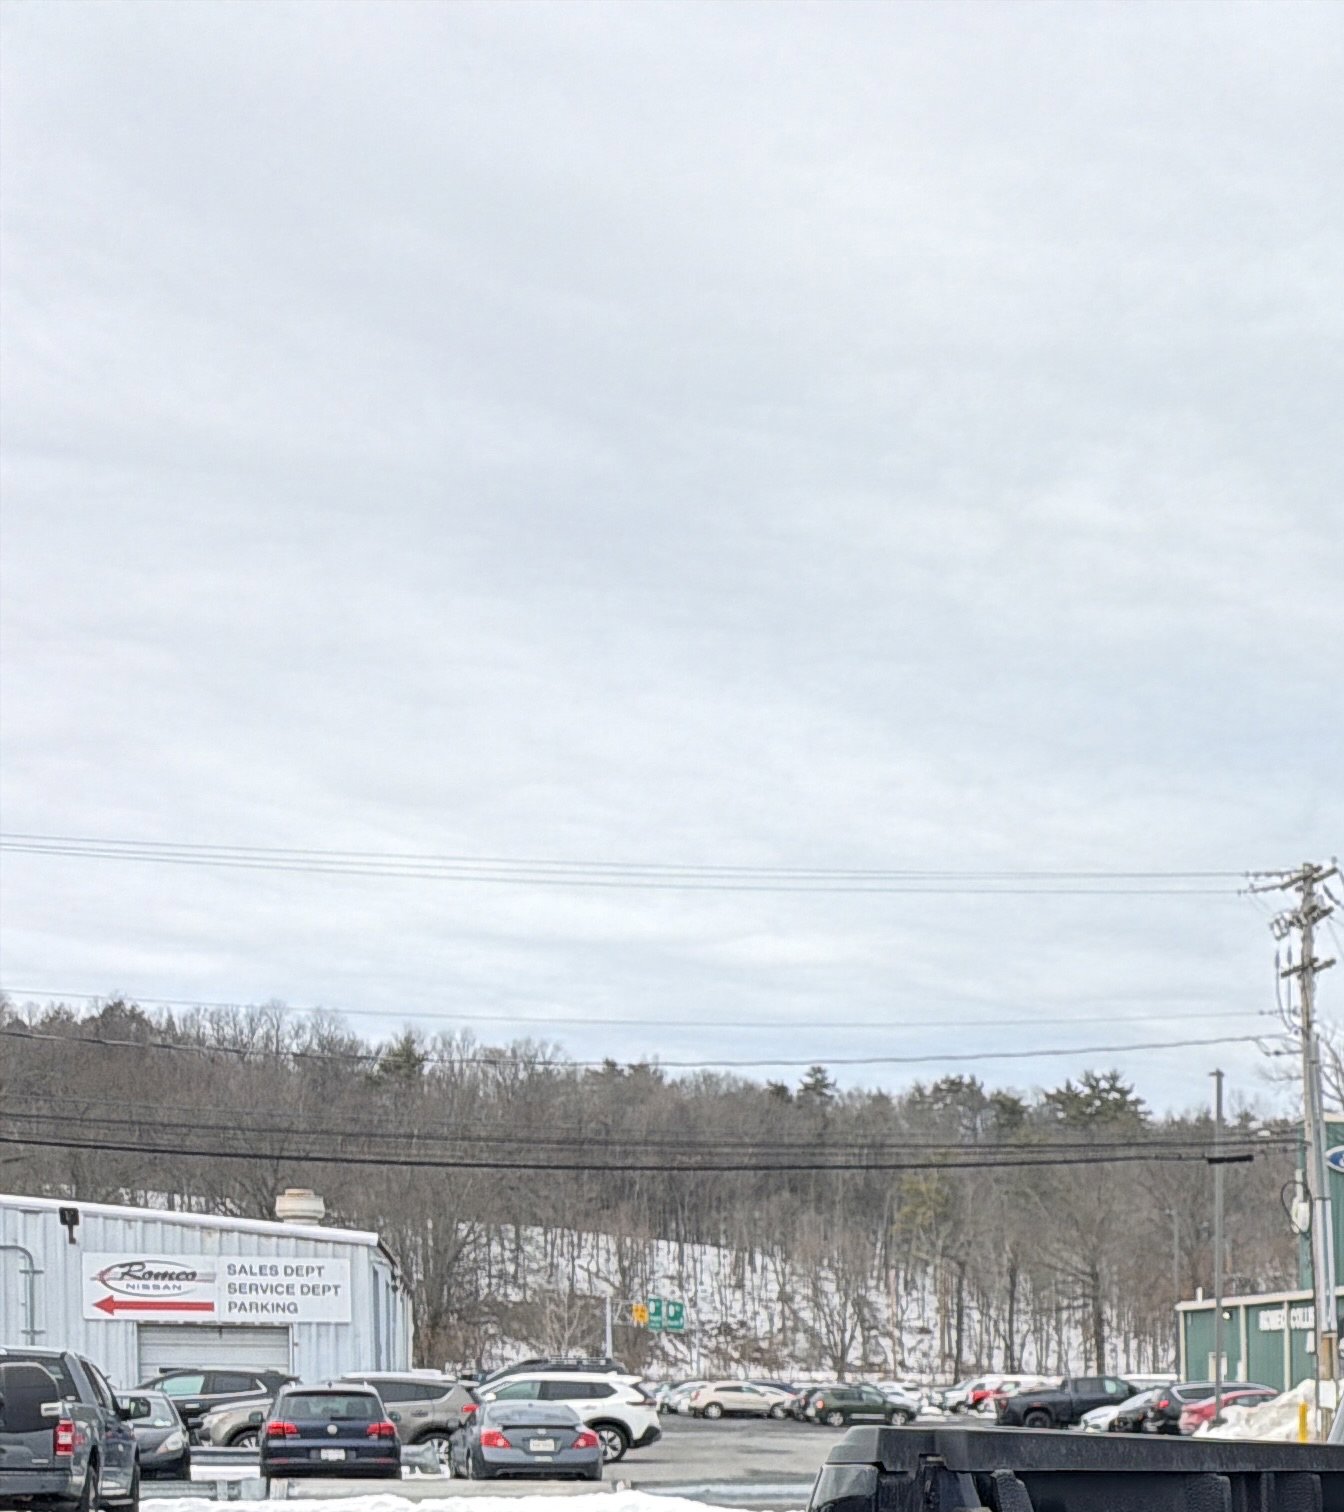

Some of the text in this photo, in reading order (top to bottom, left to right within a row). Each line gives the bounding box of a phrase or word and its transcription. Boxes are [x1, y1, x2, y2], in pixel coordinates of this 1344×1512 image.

[227, 1263, 325, 1278] SALES DEPT
[126, 1283, 182, 1291] NISSAN
[227, 1282, 341, 1297] SERVICE DEPT
[228, 1301, 299, 1314] PARKING
